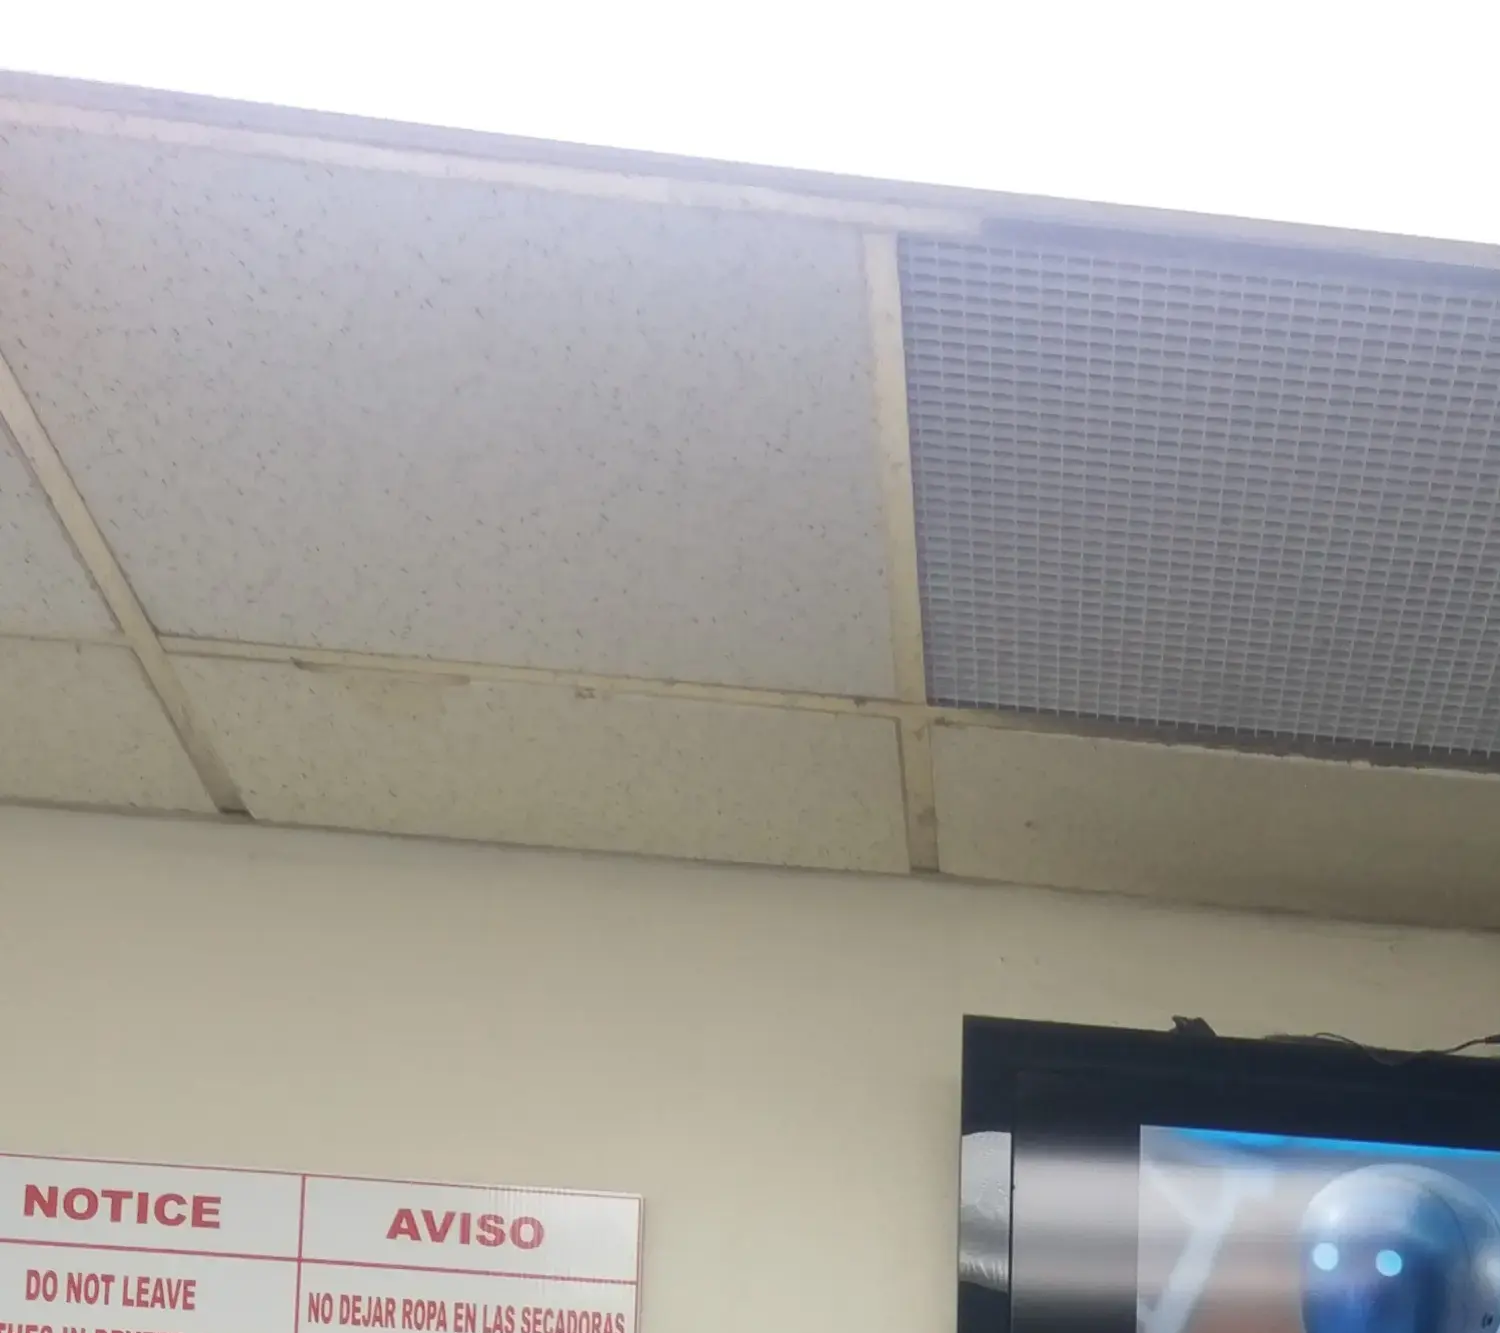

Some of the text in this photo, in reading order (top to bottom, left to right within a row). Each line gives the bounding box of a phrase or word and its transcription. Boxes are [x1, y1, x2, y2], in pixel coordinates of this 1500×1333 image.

[24, 1184, 222, 1229] NOTICE
[386, 1208, 545, 1250] AVISO
[26, 1269, 196, 1311] DO NOT LEAVE
[307, 1292, 333, 1324] NO
[339, 1294, 396, 1329] DEJAR
[401, 1298, 447, 1332] ROPA
[453, 1302, 476, 1333] EN
